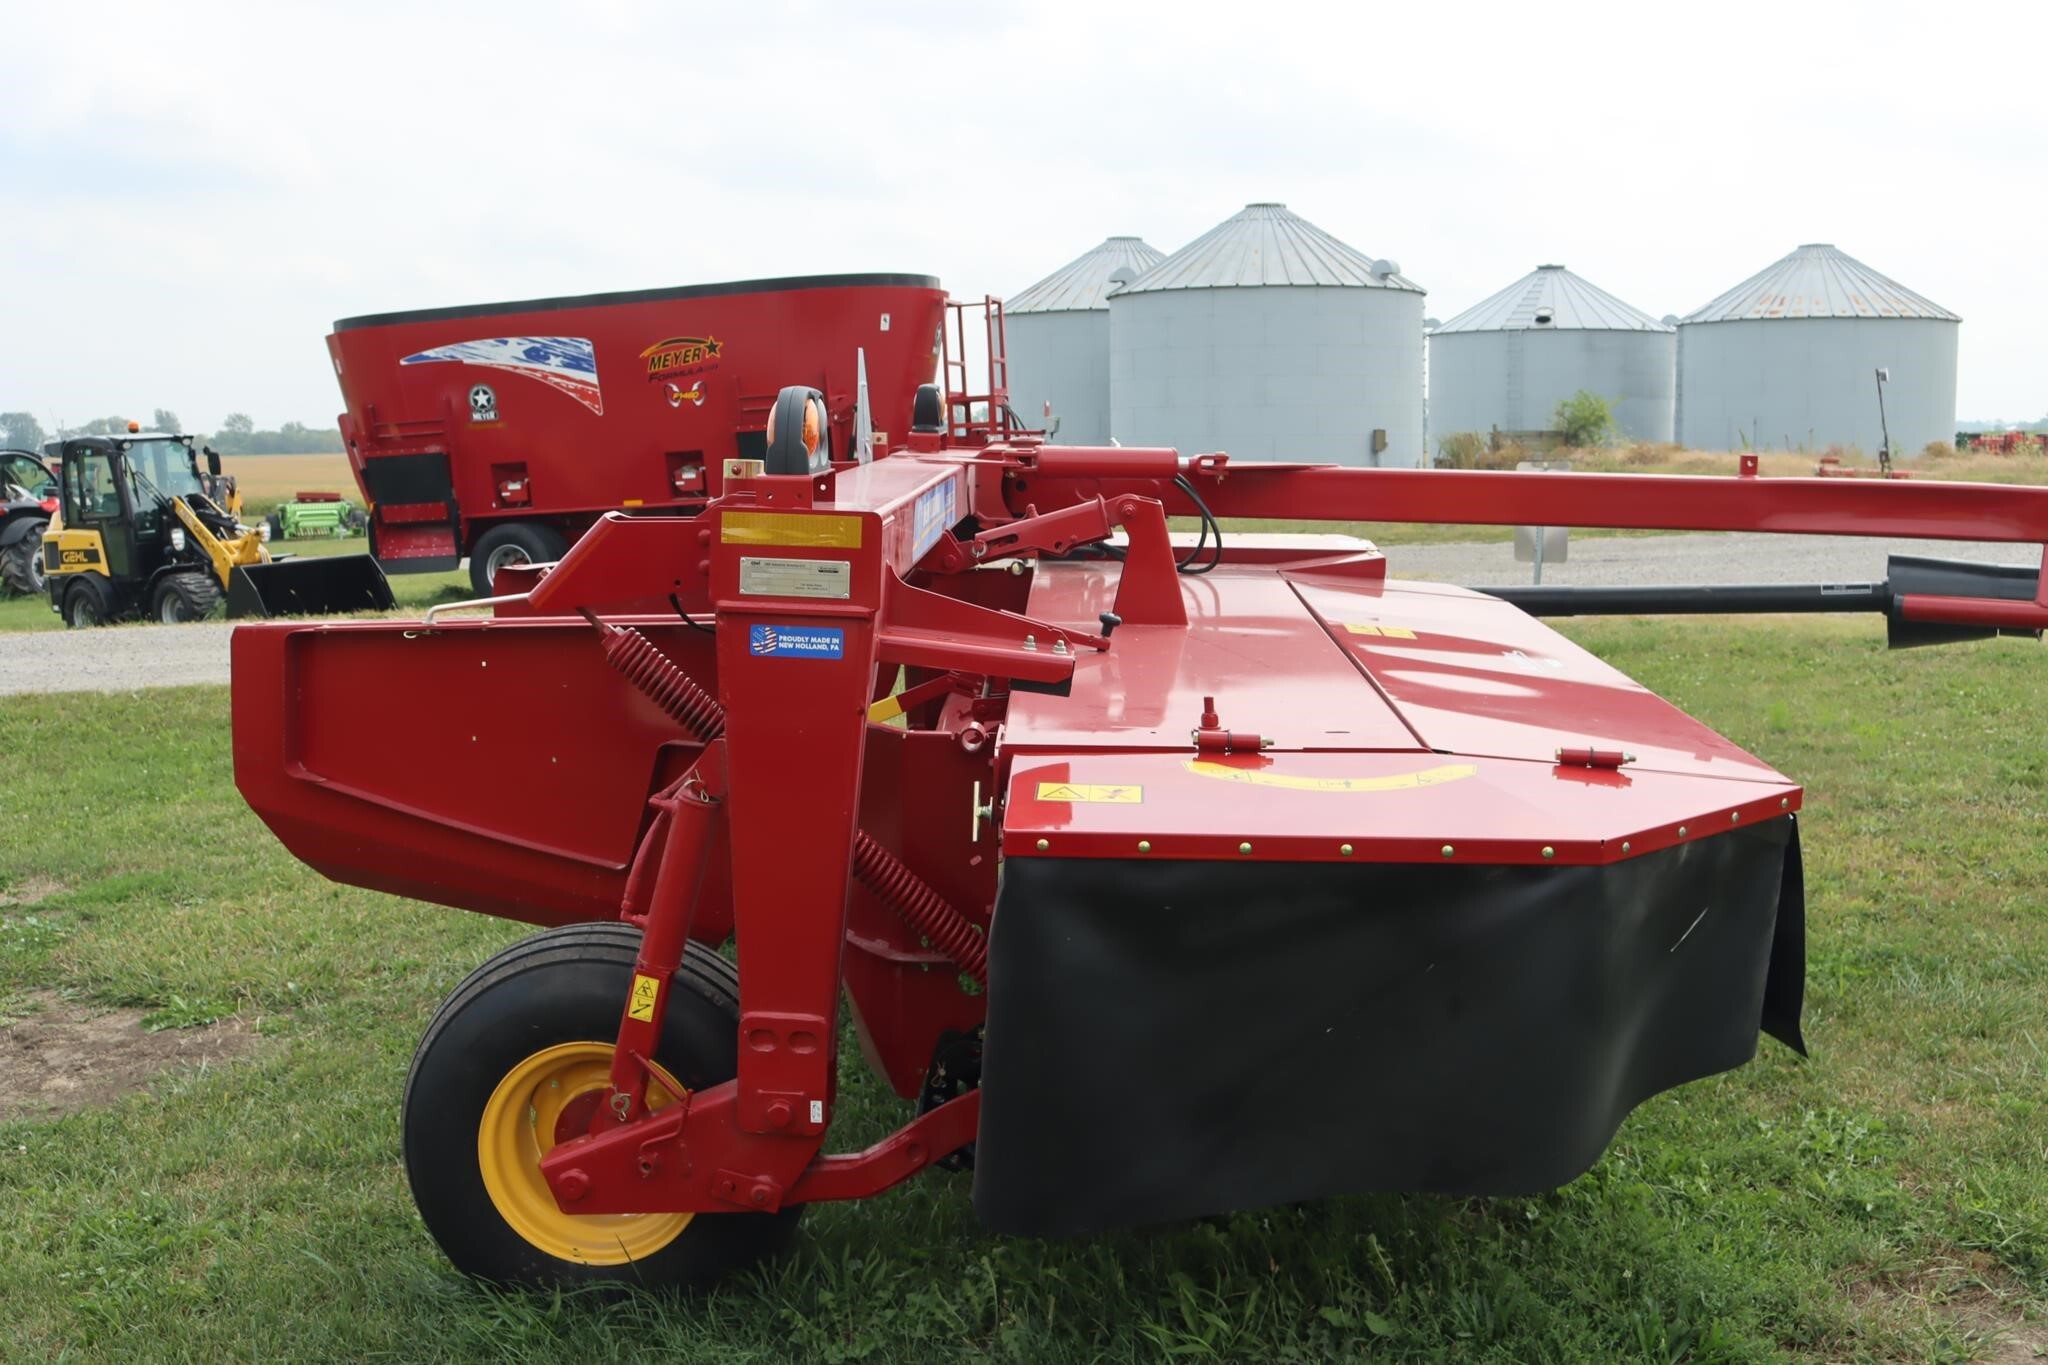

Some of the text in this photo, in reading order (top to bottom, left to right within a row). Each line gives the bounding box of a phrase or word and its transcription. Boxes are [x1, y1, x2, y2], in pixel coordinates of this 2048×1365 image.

[648, 347, 703, 372] MEYER
[62, 551, 88, 562] GEHL
[795, 643, 829, 651] HOLLAND,
